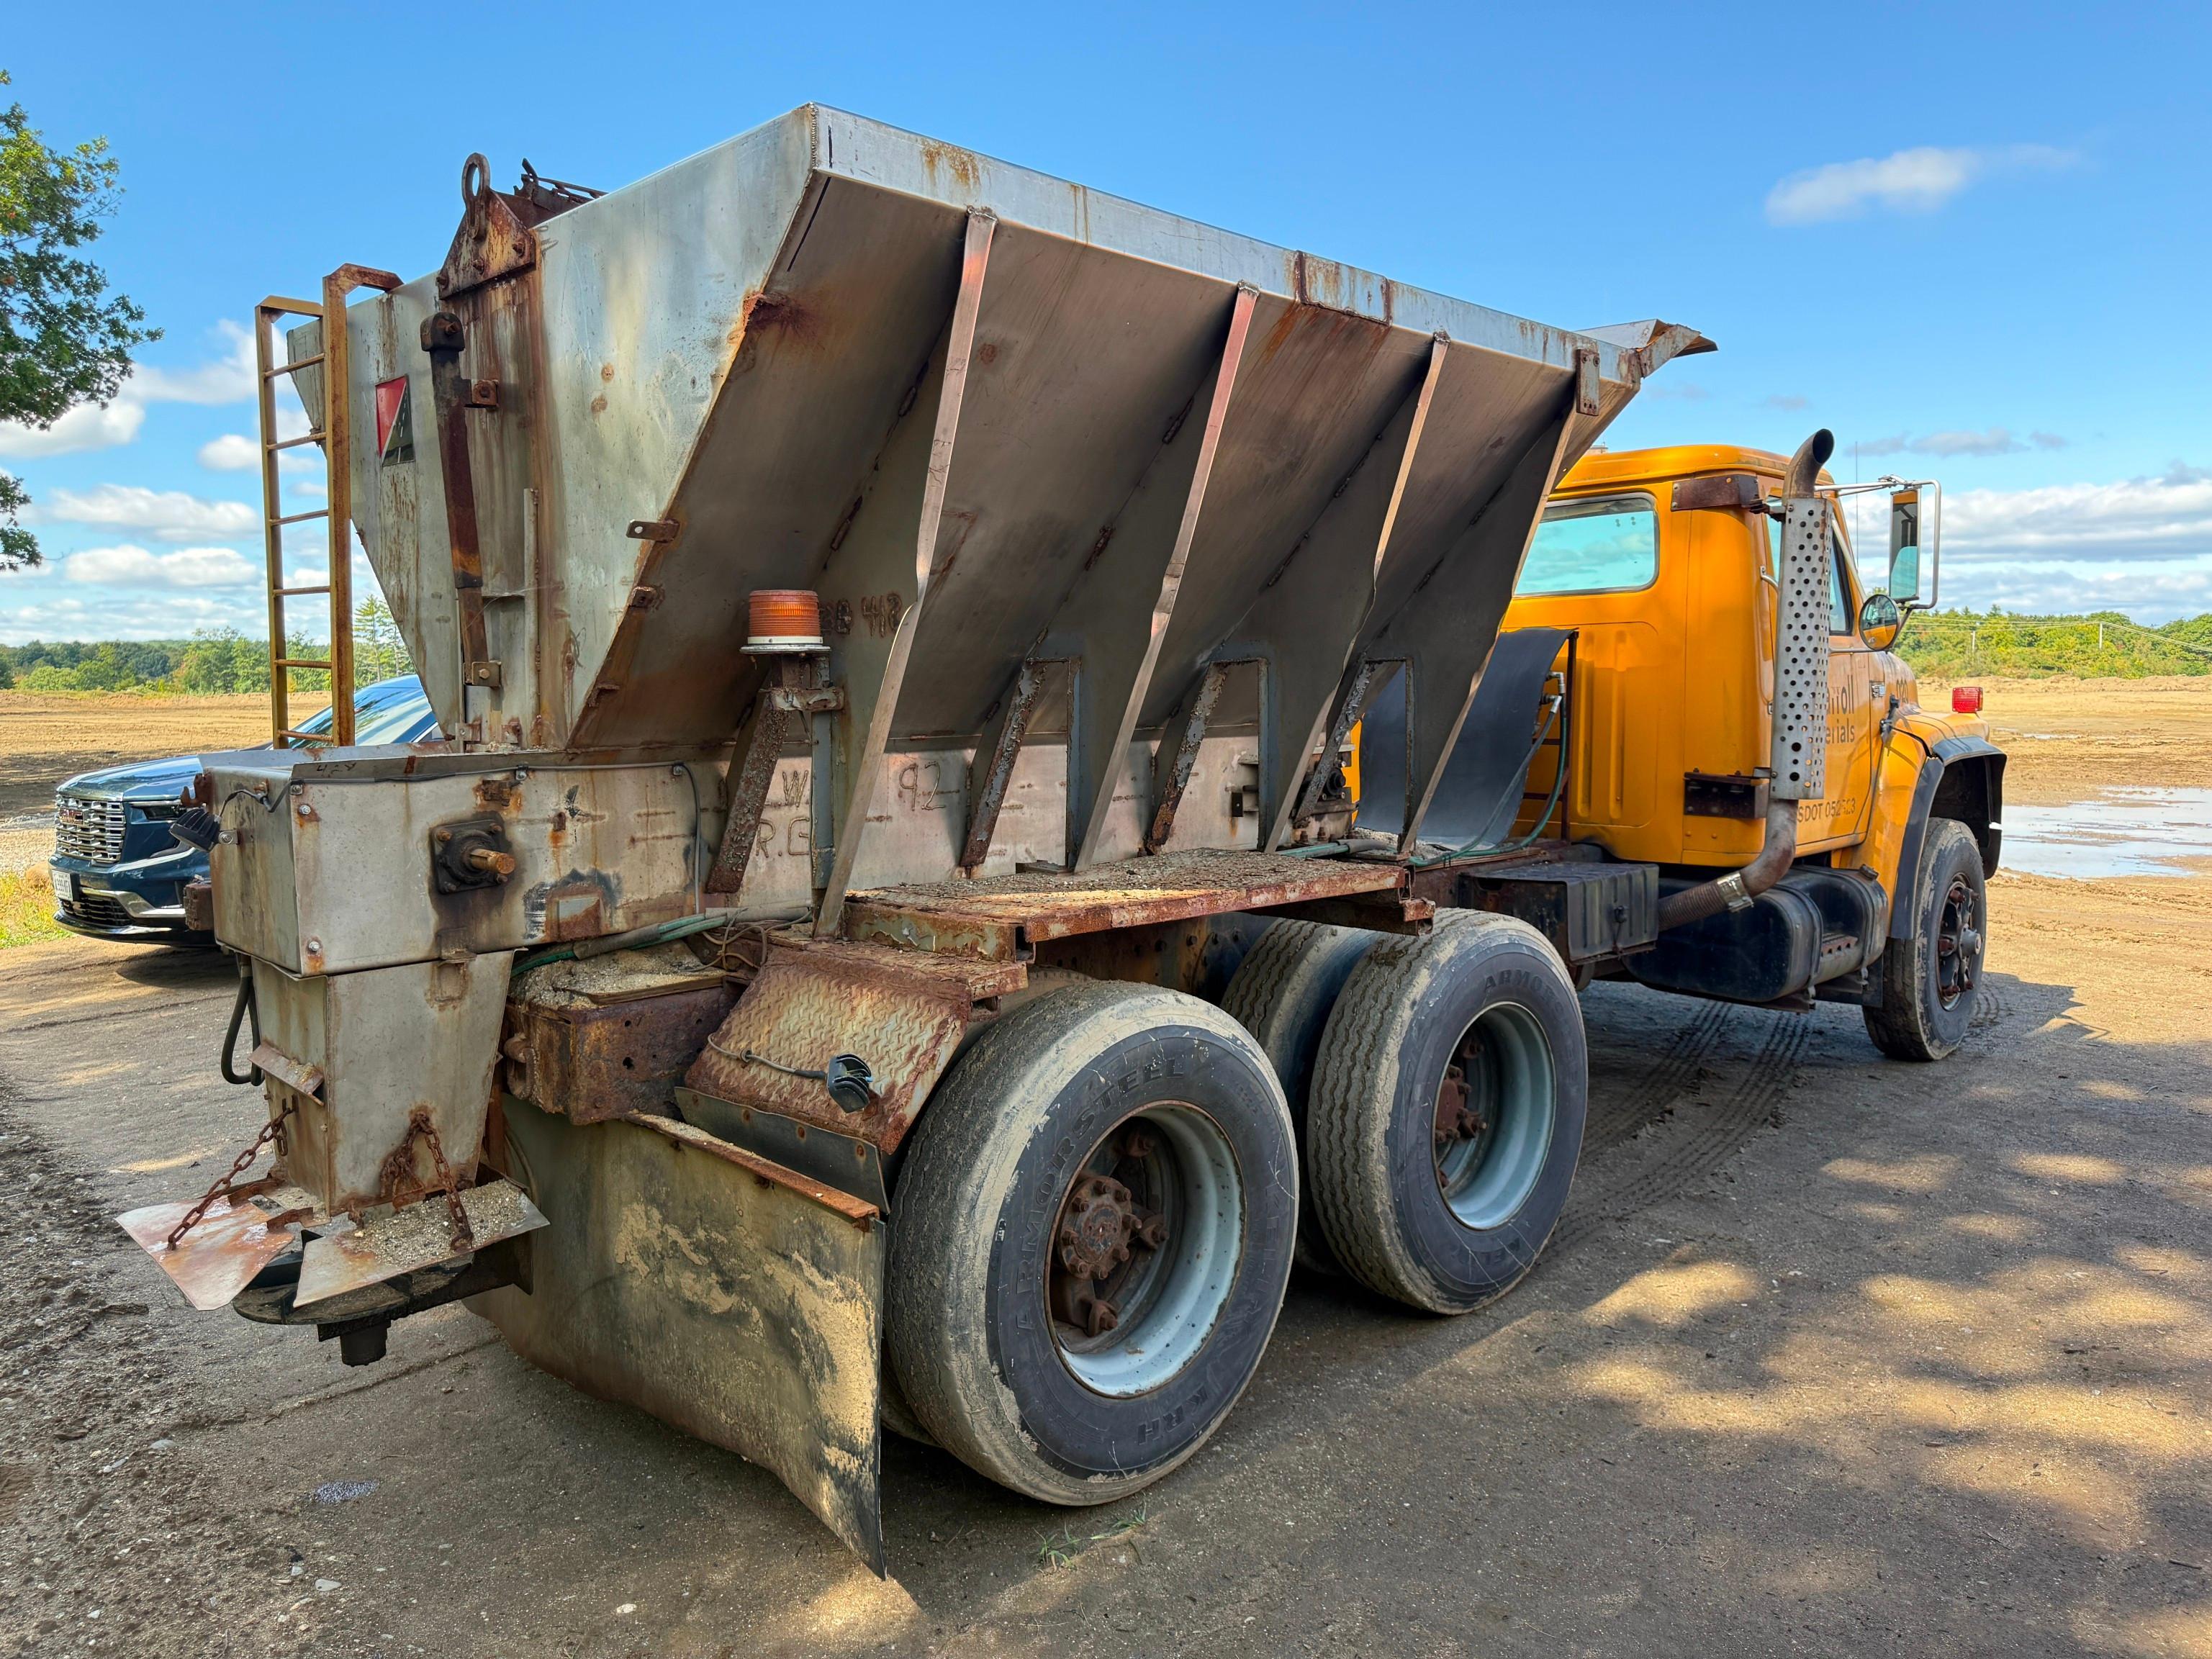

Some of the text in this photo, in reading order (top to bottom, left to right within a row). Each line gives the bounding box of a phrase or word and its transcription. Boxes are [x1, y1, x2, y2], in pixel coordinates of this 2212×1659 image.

[1826, 674, 1854, 714] arroll
[1825, 718, 1855, 745] erials
[1797, 803, 1823, 823] SDOT
